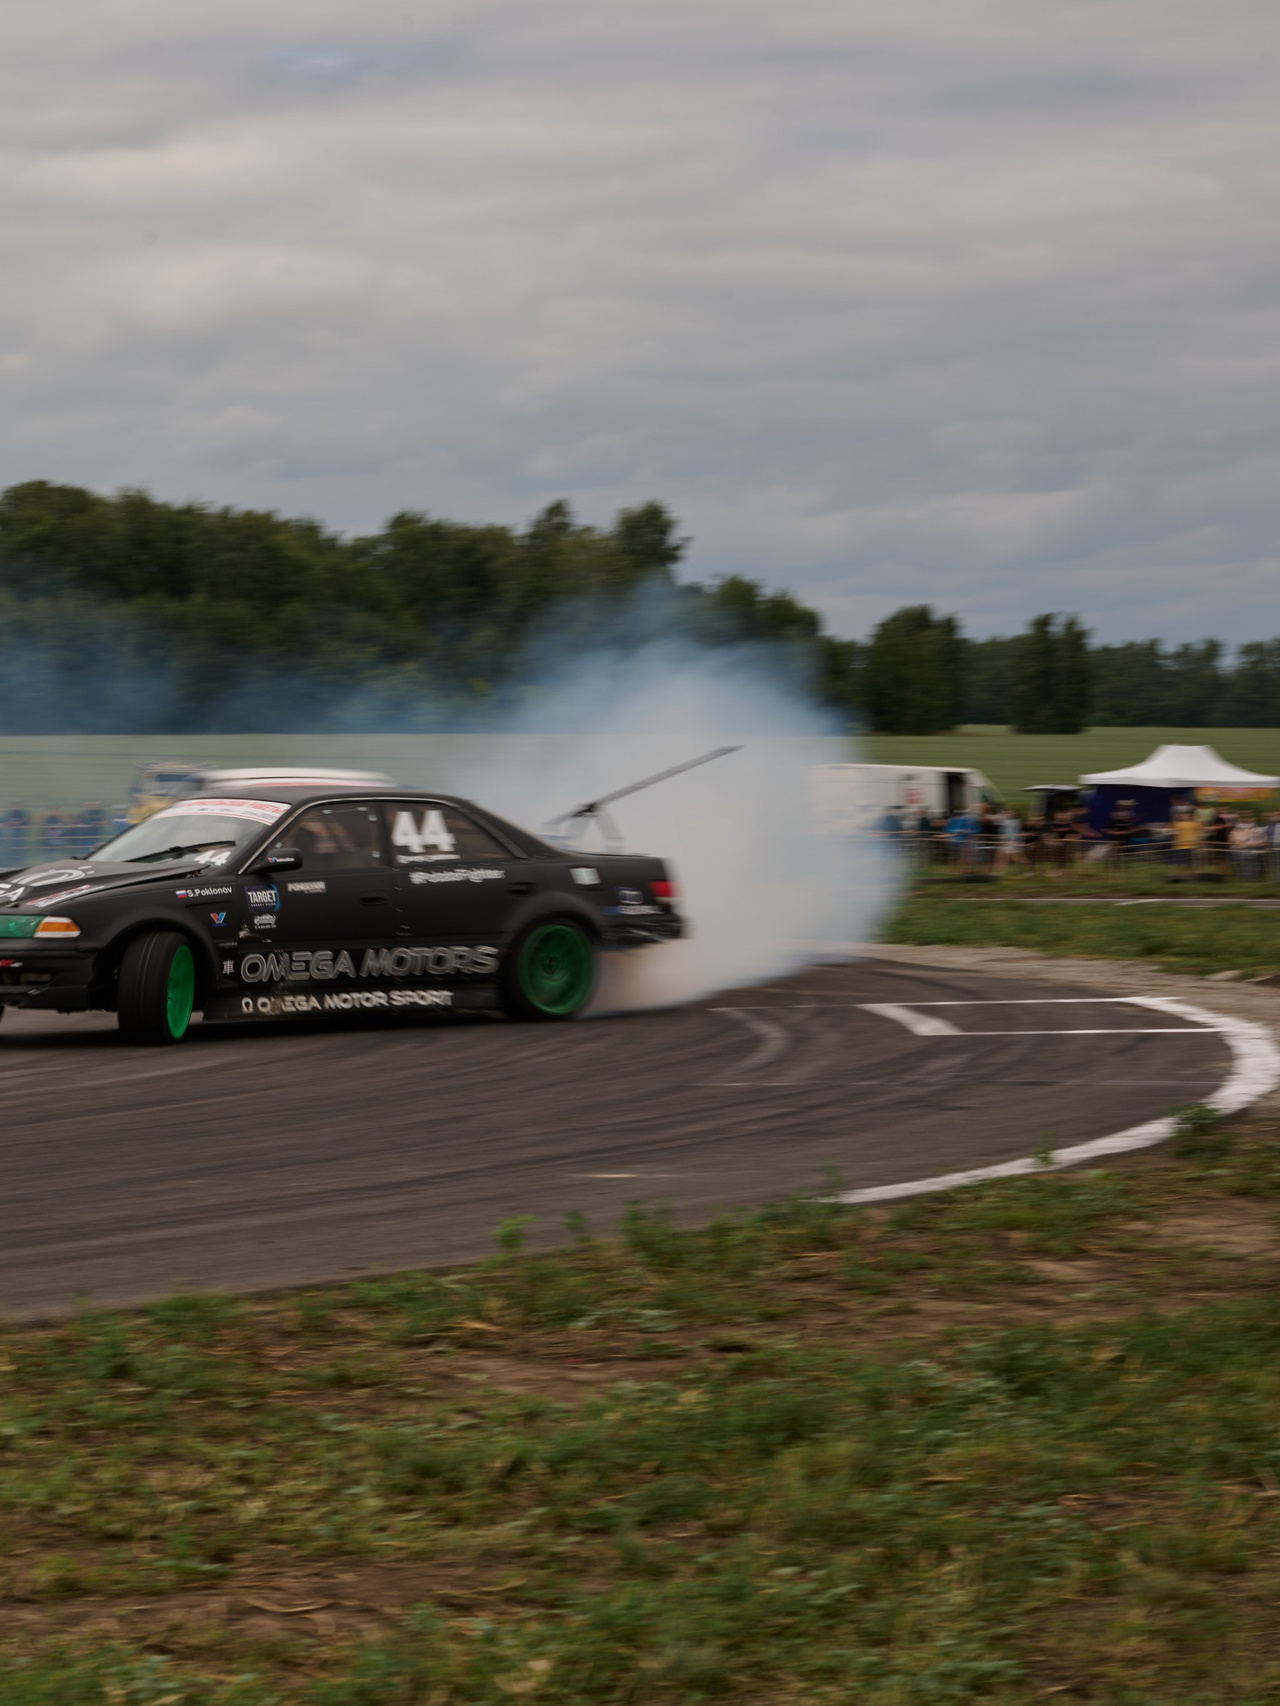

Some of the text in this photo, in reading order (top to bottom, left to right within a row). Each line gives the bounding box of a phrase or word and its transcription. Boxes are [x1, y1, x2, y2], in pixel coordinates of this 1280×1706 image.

[391, 810, 456, 853] 44
[193, 850, 232, 866] 44
[247, 890, 277, 904] TARGET
[241, 945, 500, 983] OMEGA MOTORS
[324, 990, 390, 1010] MOTOR
[389, 989, 455, 1007] SPORT
